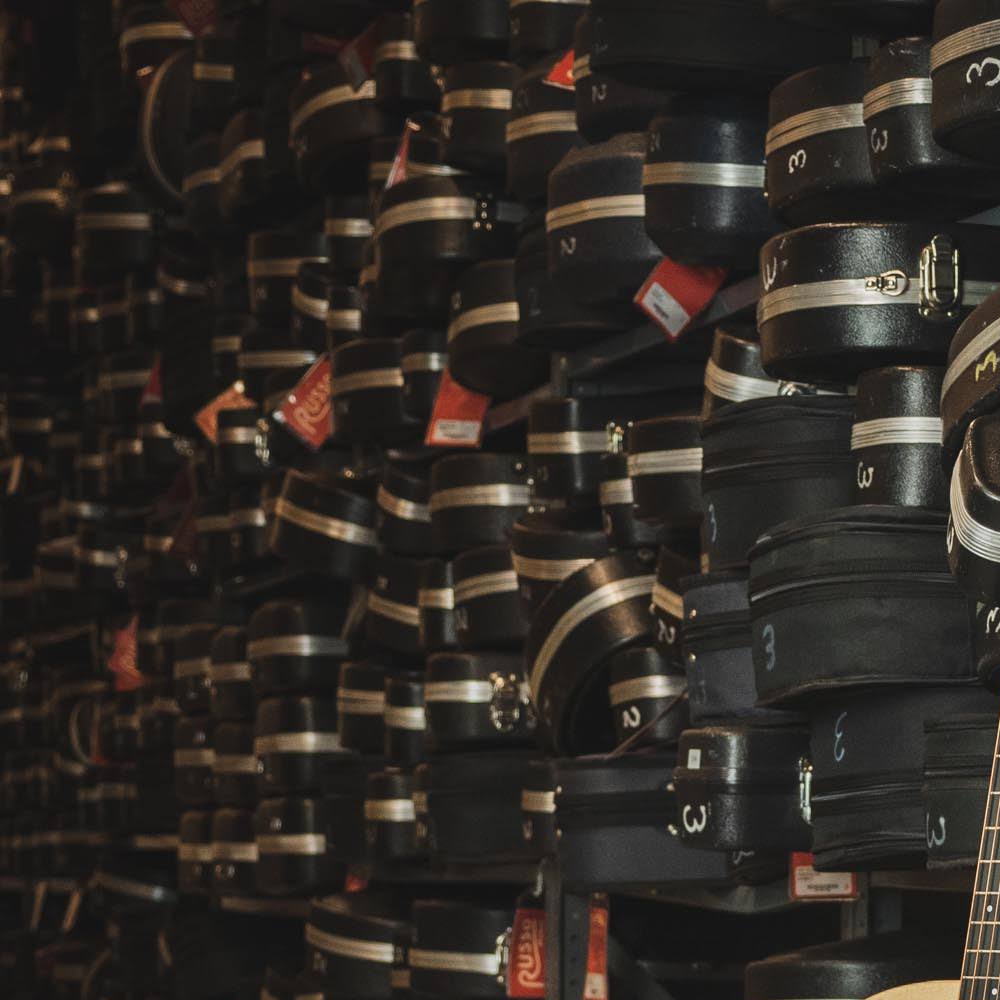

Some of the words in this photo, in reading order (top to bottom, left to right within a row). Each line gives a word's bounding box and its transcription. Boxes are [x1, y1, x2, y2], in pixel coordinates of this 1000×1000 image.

[871, 127, 888, 151] 3
[789, 149, 806, 175] 3
[857, 461, 873, 489] 3
[658, 619, 676, 644] 2
[762, 624, 776, 671] 3
[622, 706, 641, 728] 2
[683, 804, 707, 833] 3
[926, 813, 947, 847] 3
